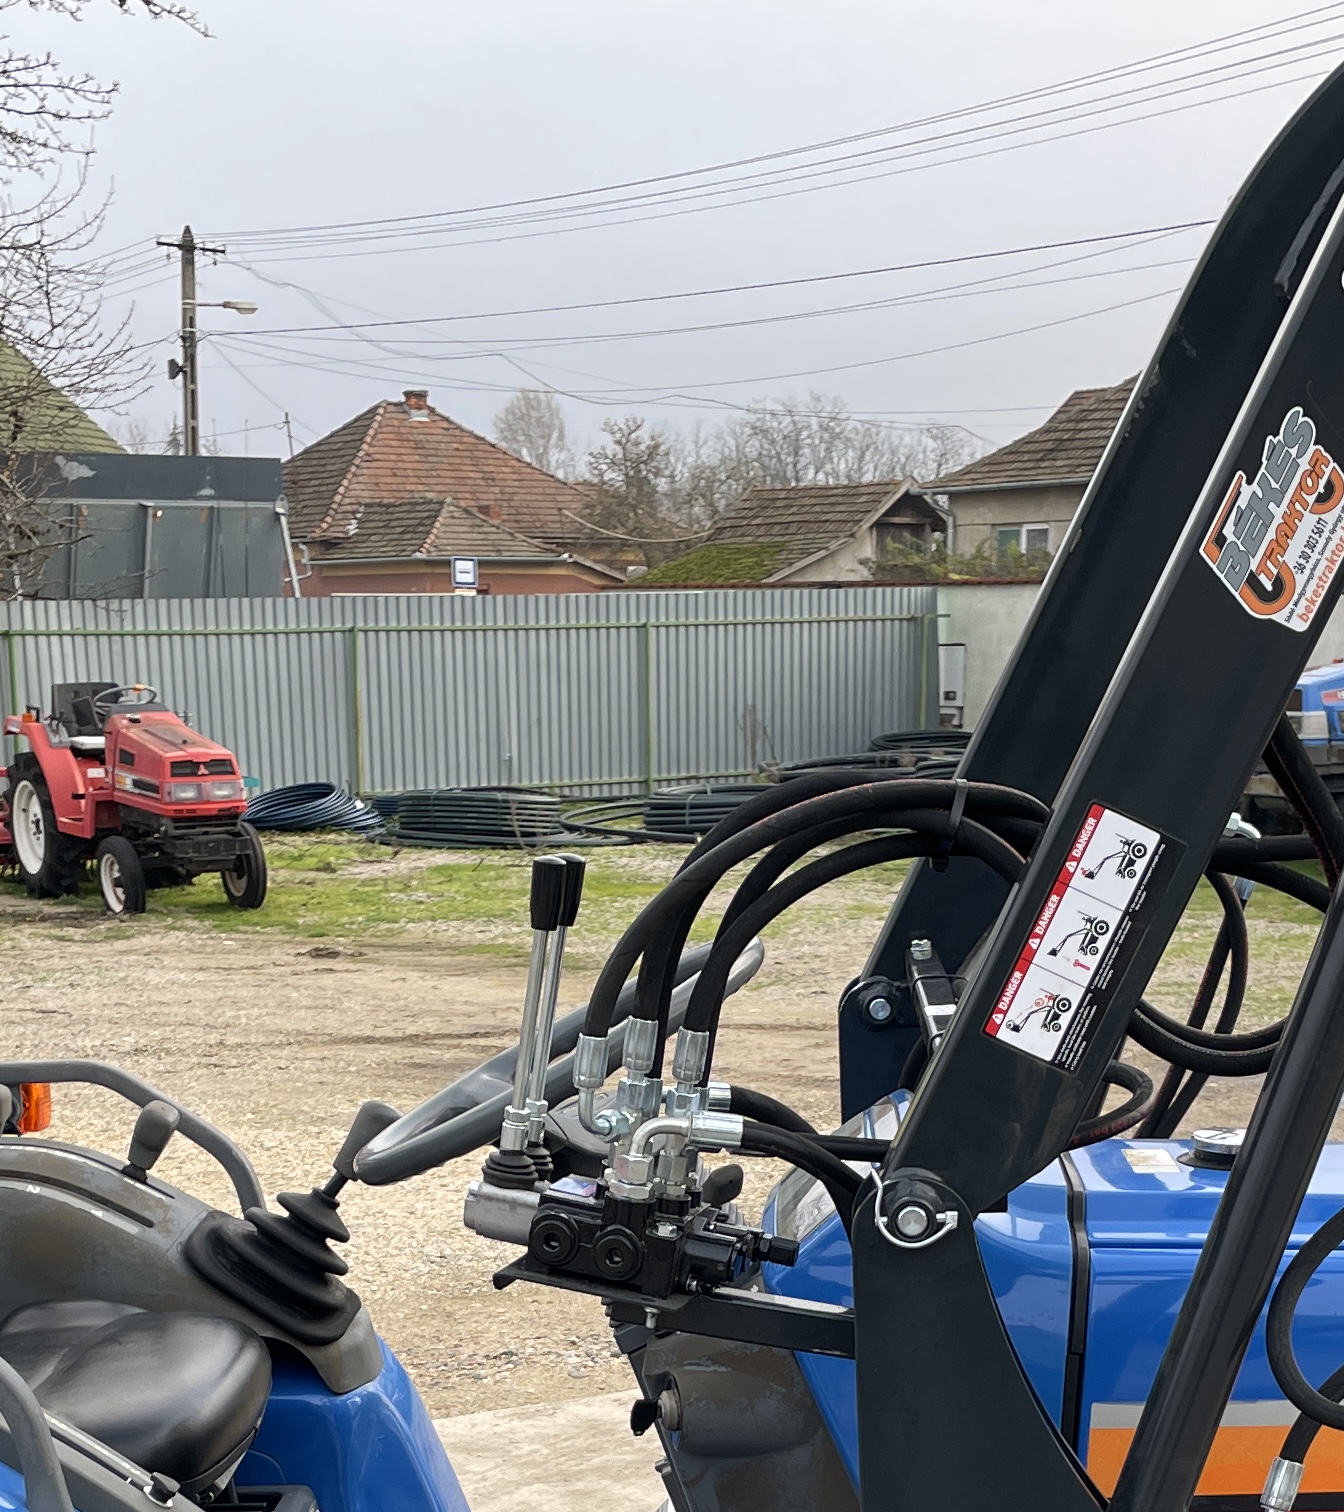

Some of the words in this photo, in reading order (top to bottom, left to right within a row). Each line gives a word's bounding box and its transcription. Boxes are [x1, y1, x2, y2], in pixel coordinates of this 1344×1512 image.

[1216, 410, 1314, 592] BÉKÉS
[1256, 448, 1330, 581] TRAKTOR
[1302, 534, 1320, 553] 303
[1310, 517, 1328, 538] 5611
[1297, 549, 1312, 563] 30
[1072, 816, 1097, 858] DANGER
[1035, 894, 1060, 935] DANGER
[998, 970, 1023, 1011] DANGER
